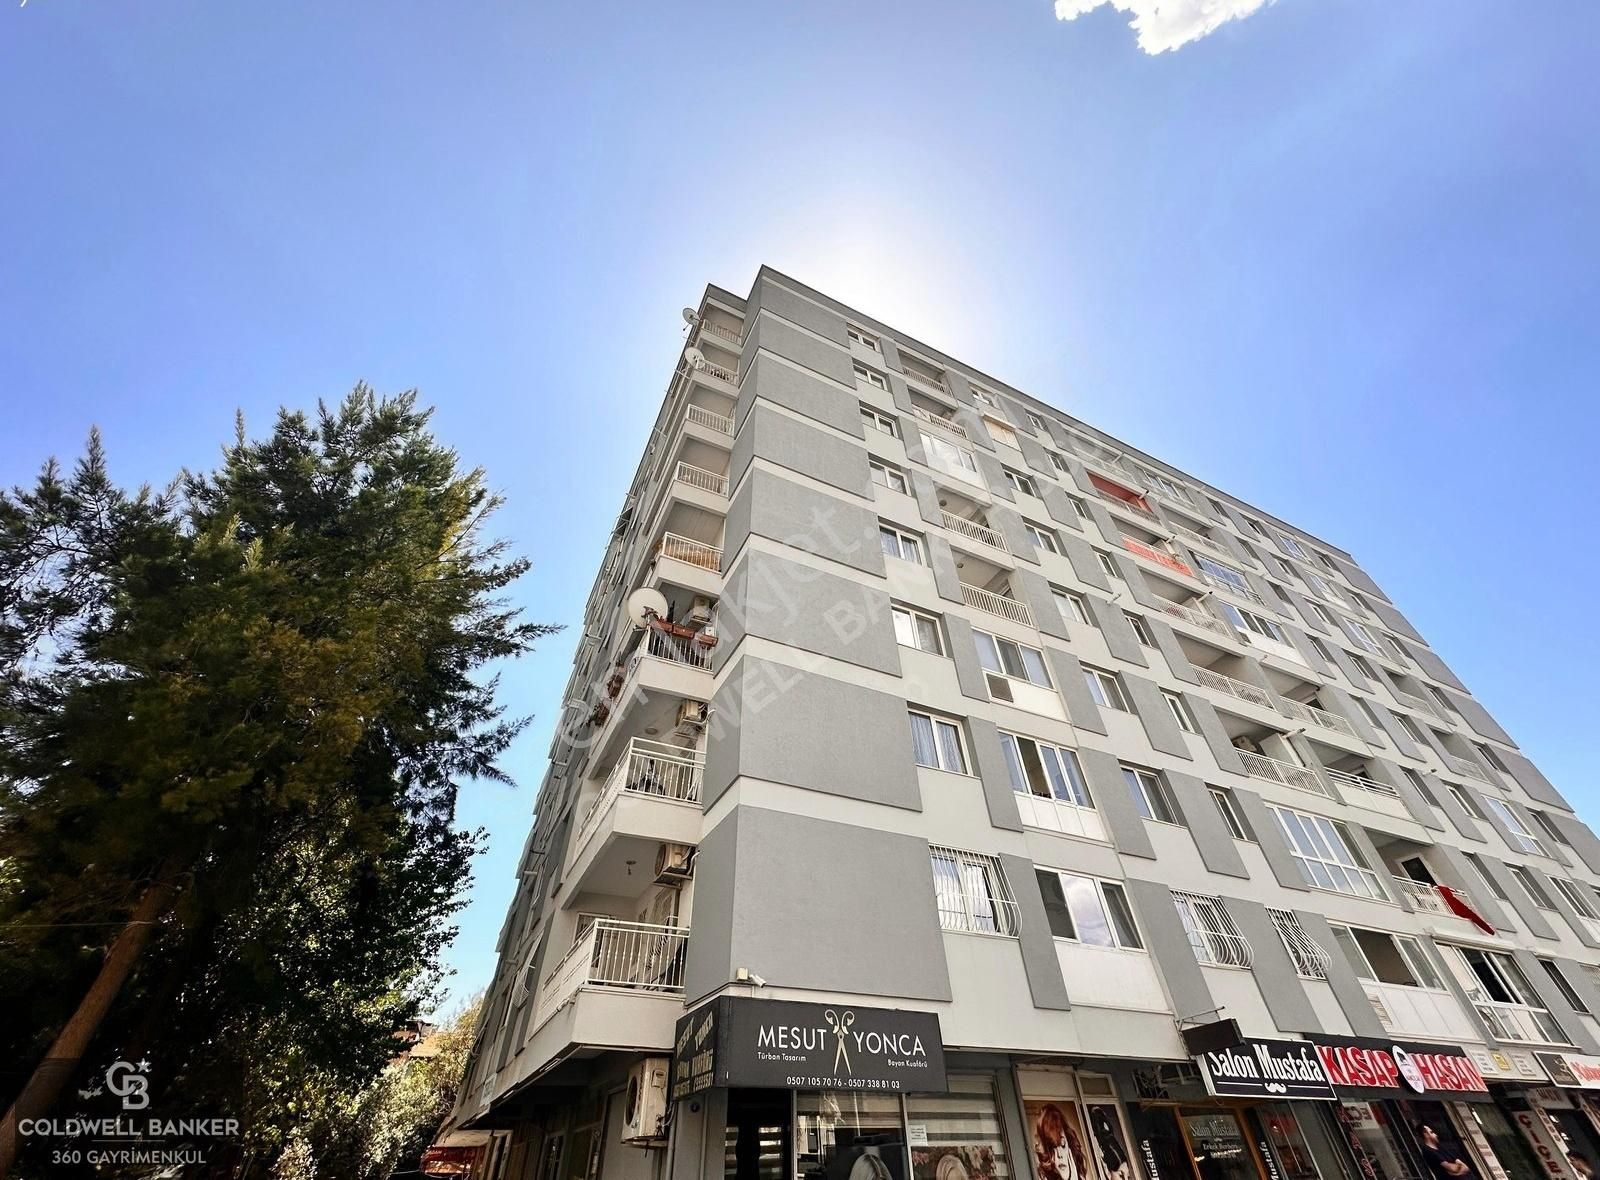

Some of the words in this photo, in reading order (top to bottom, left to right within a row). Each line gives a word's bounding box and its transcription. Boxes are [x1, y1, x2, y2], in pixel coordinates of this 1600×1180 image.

[757, 1025, 827, 1051] MESUT
[854, 1031, 927, 1057] YONCA
[757, 1052, 780, 1061] Türban
[781, 1053, 807, 1062] Tasarım
[887, 1058, 904, 1068] Bayan
[906, 1059, 928, 1068] Kuaförü
[1210, 1048, 1259, 1079] Salon
[1253, 1043, 1325, 1082] Mustafa
[1316, 1045, 1399, 1088] KASAP
[1409, 1053, 1489, 1092] HASAN
[786, 1076, 806, 1086] 0507
[807, 1077, 820, 1086] 105
[822, 1077, 832, 1087] 70
[833, 1078, 842, 1087] 76
[848, 1079, 866, 1088] 0507
[867, 1080, 879, 1088] 338
[880, 1080, 890, 1089] 81
[891, 1080, 900, 1089] 03
[1142, 1138, 1160, 1180] ustafa
